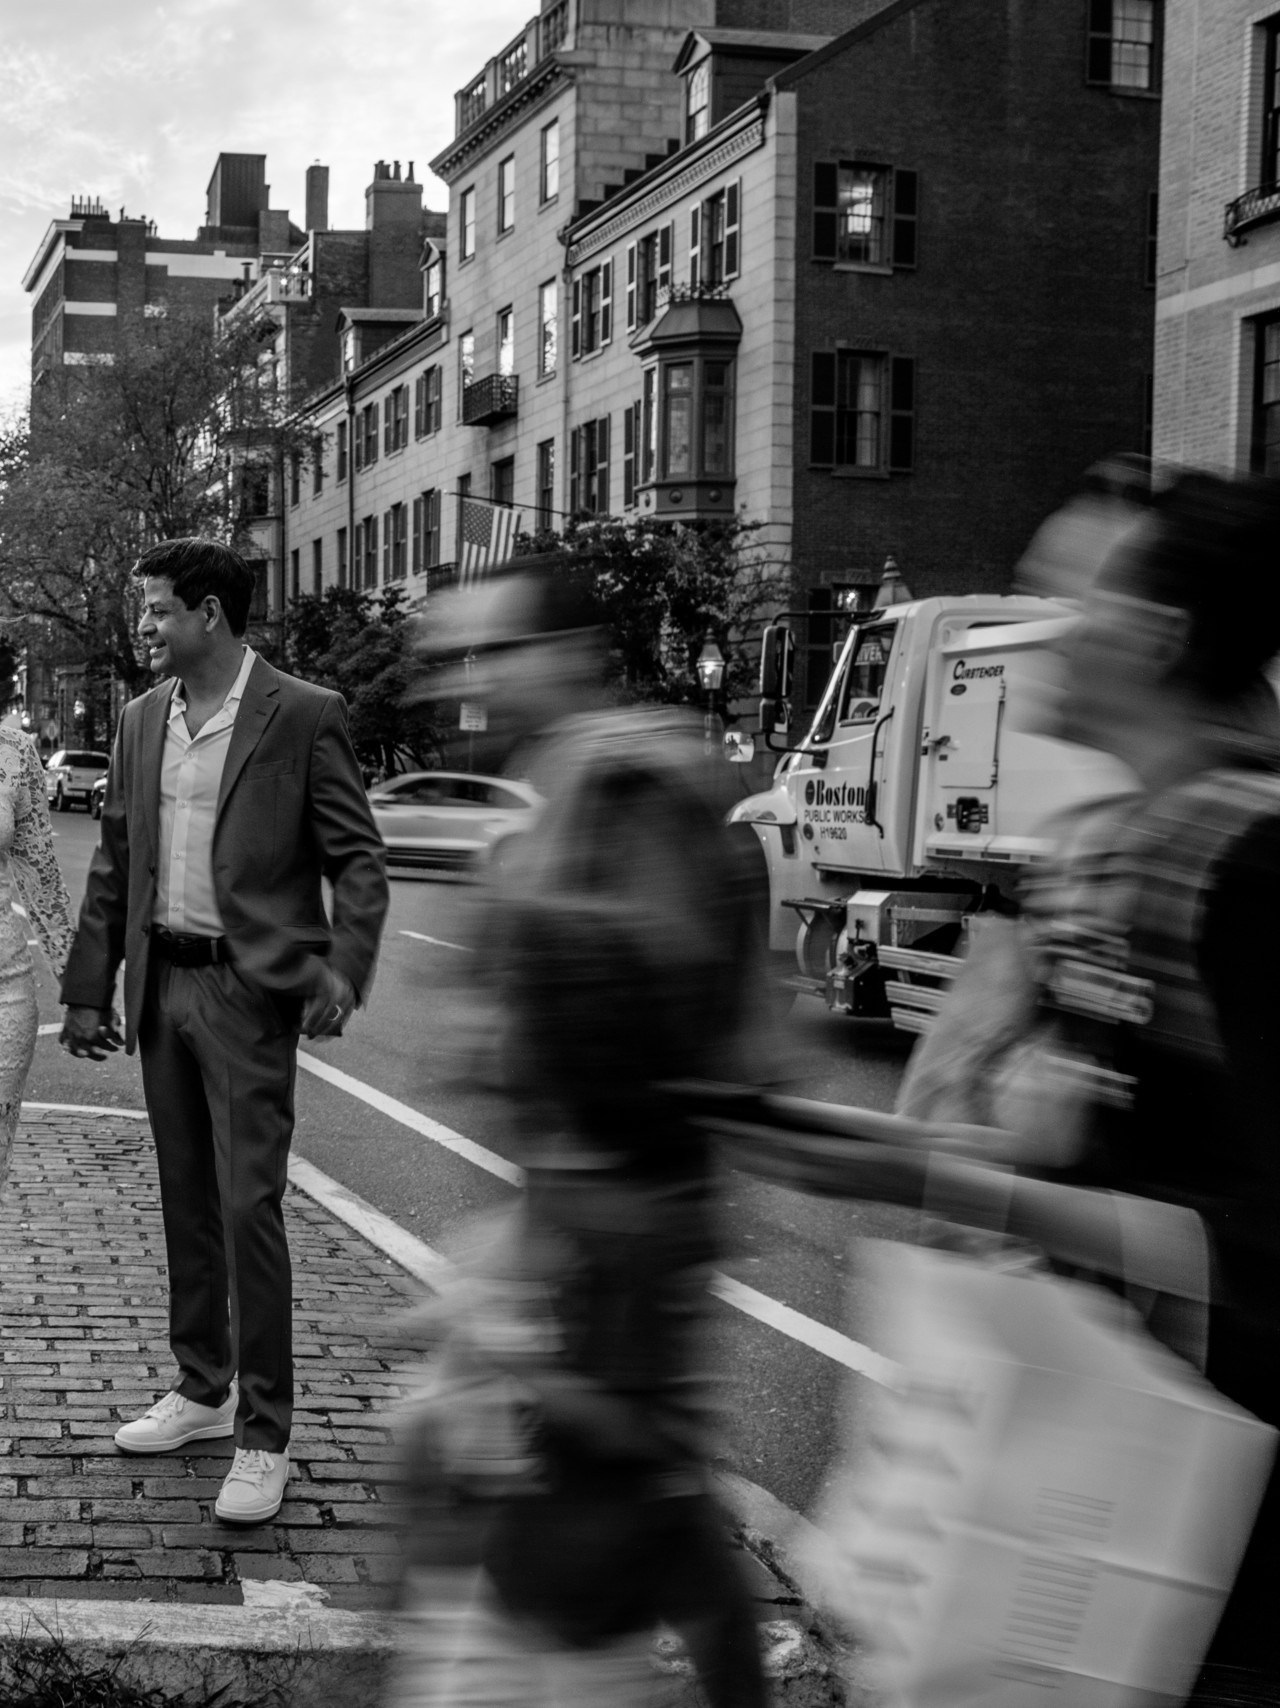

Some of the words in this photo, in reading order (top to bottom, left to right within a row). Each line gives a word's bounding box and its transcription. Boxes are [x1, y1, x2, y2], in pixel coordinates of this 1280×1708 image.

[856, 646, 882, 662] IVER
[816, 779, 865, 806] Boston
[804, 809, 831, 823] PUBLIC
[833, 809, 866, 824] WORKS
